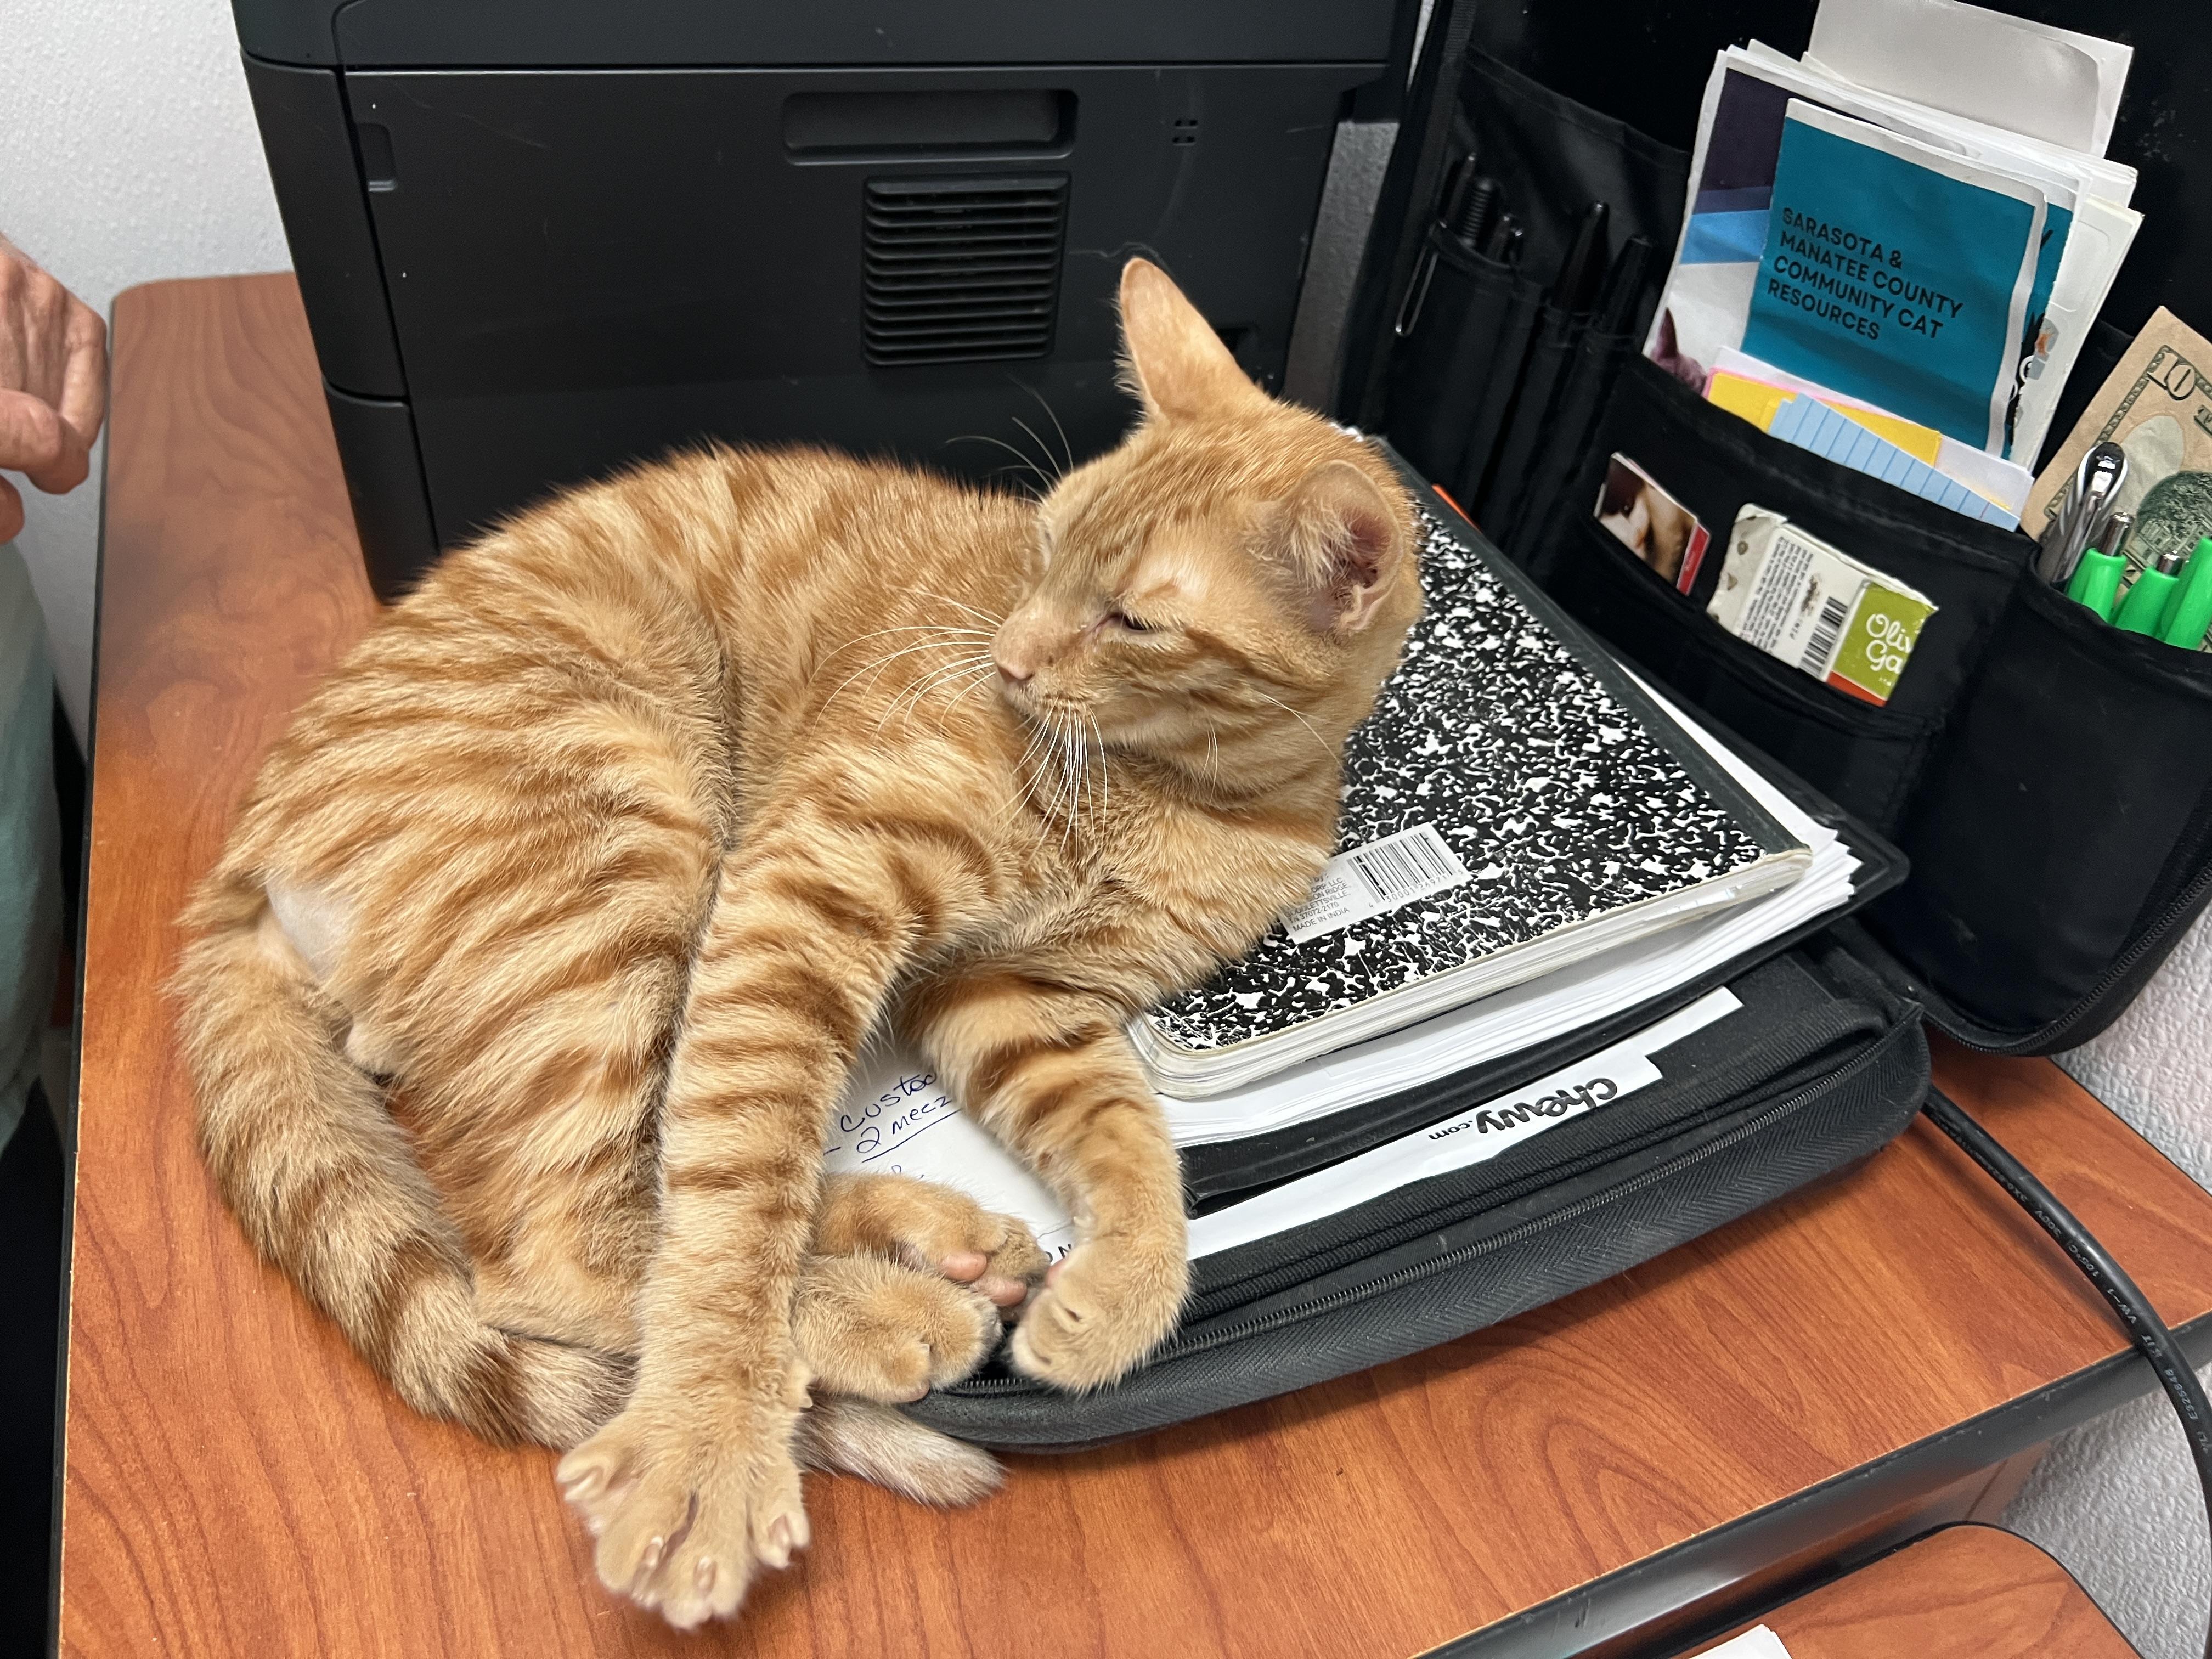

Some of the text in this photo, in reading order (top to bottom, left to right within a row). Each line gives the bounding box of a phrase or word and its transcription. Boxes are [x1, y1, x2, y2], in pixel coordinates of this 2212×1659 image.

[1782, 207, 1902, 270] SARASOTA &
[1773, 255, 1944, 338] COMMUNITY CAT
[1780, 230, 1964, 318] MANATEE COUNTY
[1767, 277, 1880, 340] RESOURCES
[2146, 352, 2196, 401] 10
[1292, 918, 1318, 932] MADE
[1328, 907, 1351, 919] INDIA
